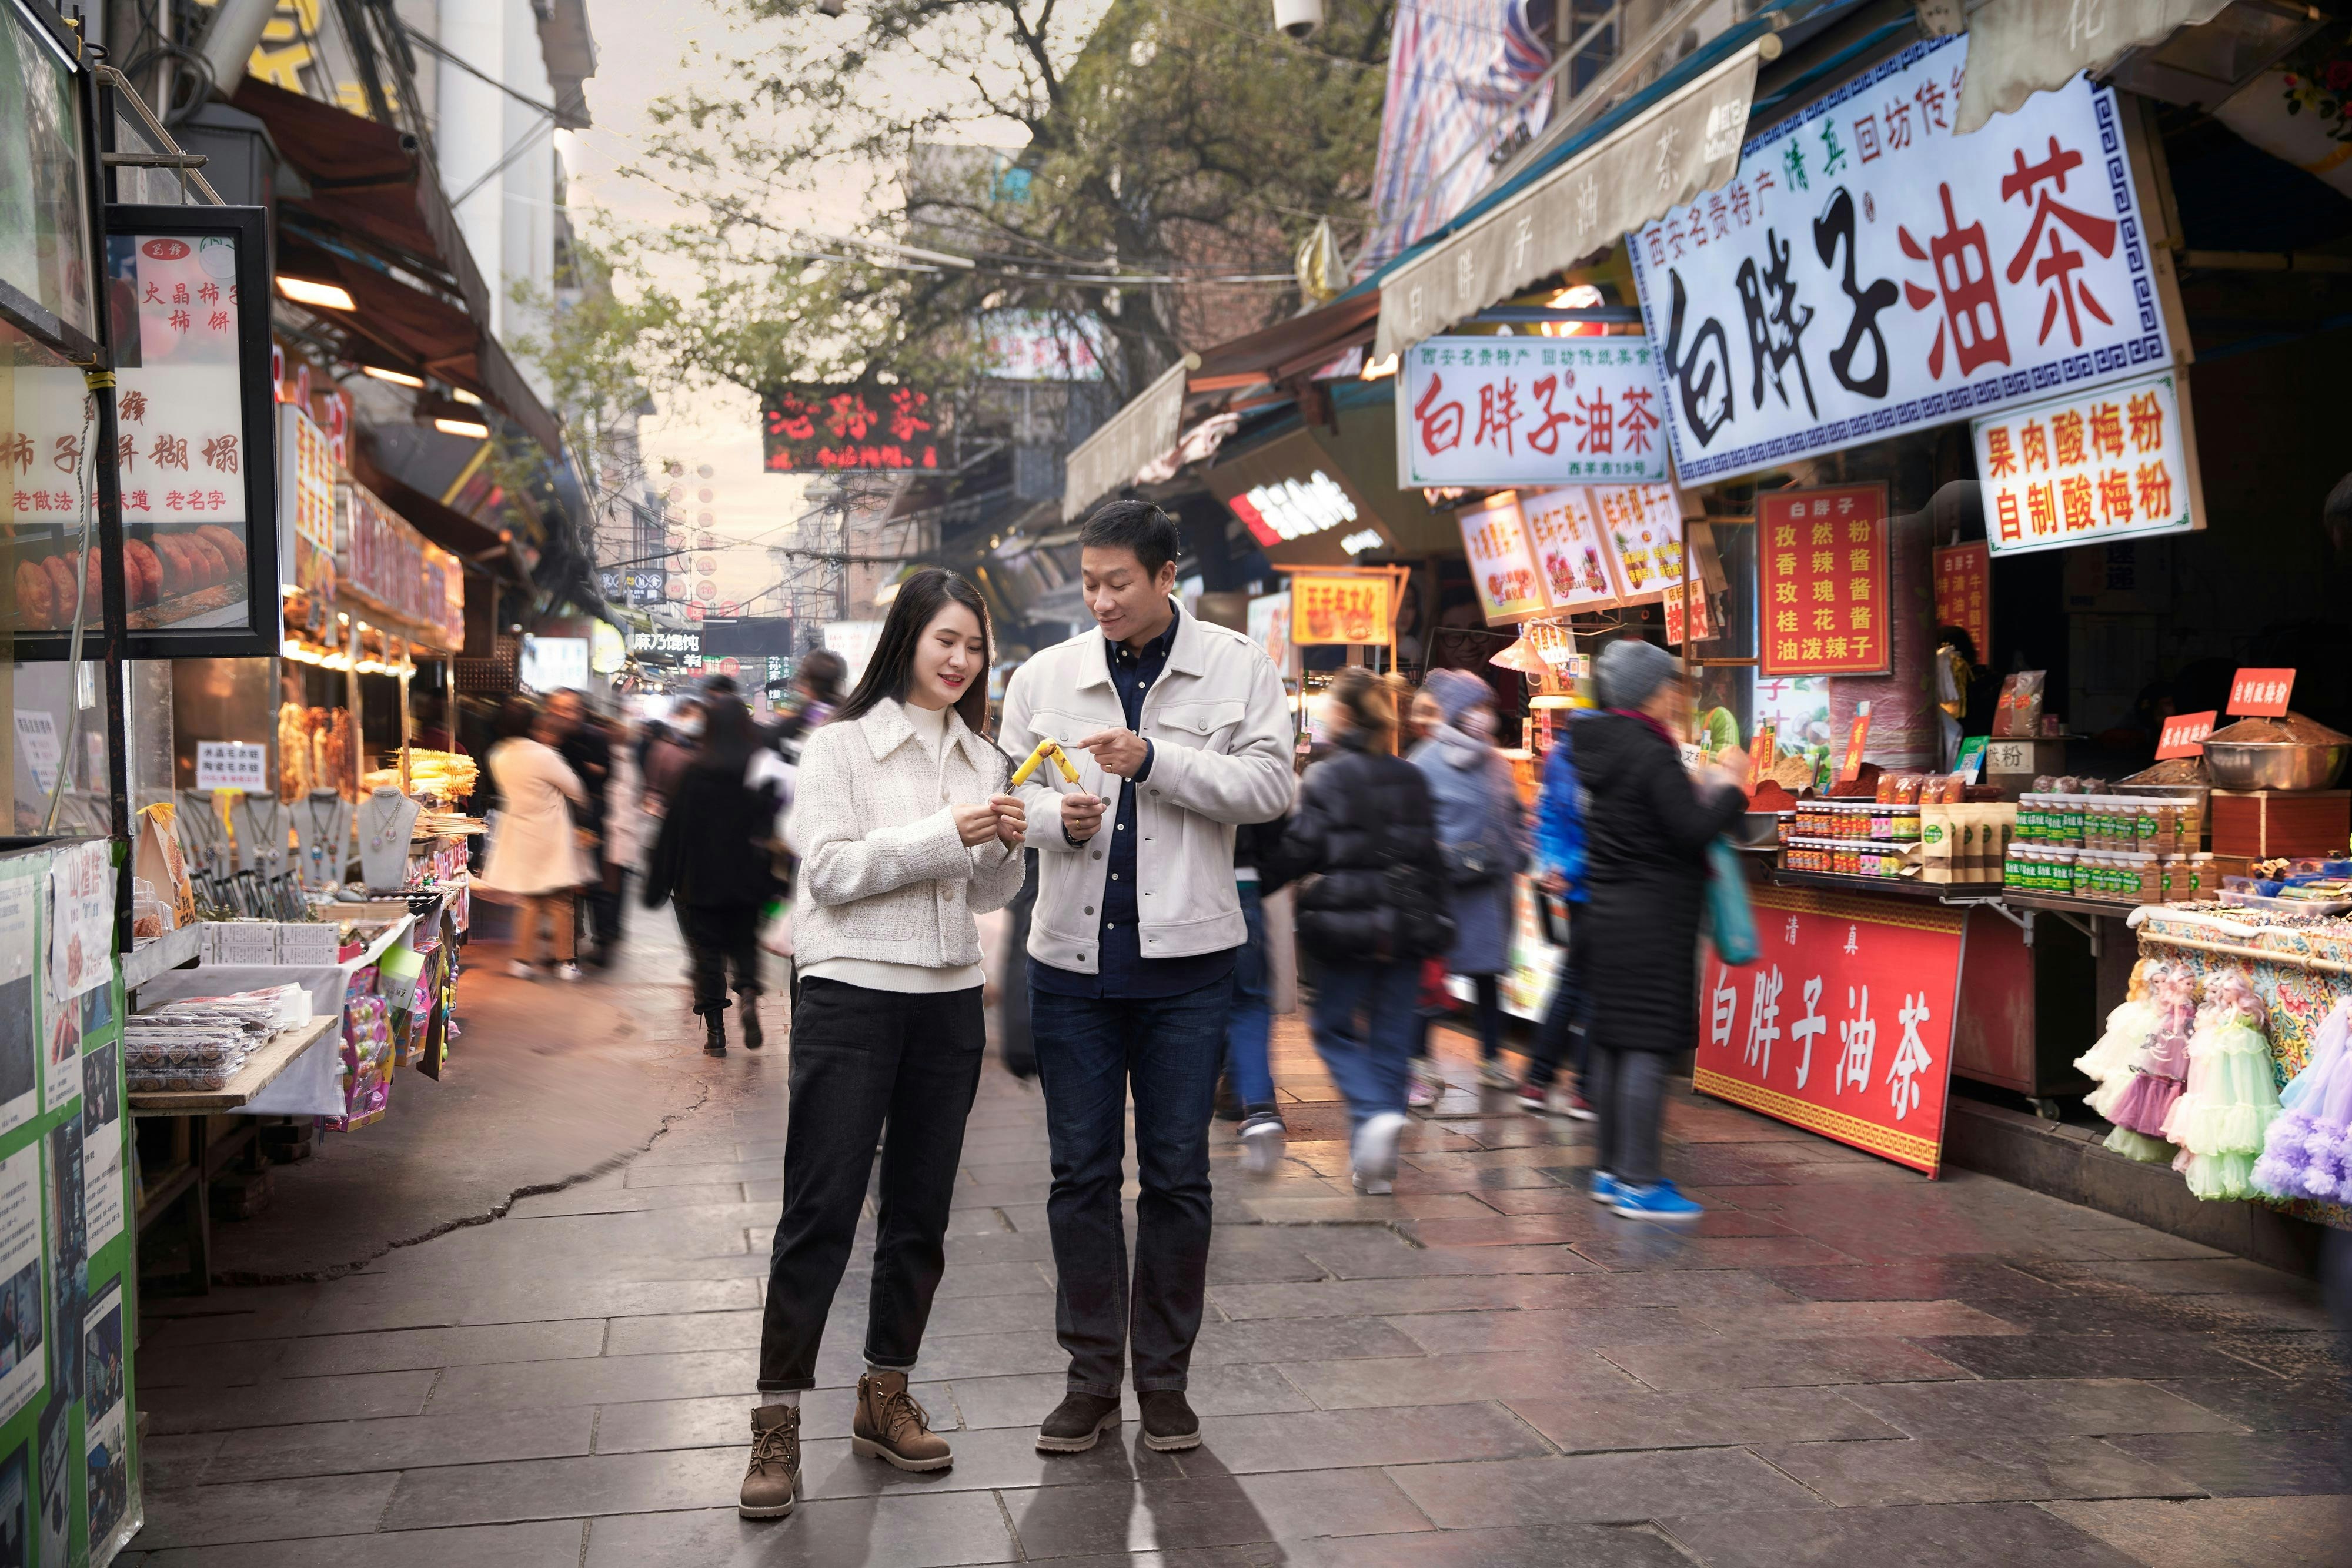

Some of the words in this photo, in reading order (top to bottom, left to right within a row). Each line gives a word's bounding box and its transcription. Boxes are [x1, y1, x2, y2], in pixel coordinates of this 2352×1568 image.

[1647, 169, 1776, 266] 西安名贵特产
[1783, 118, 1847, 192] 清真
[1666, 135, 2117, 447] 白胖子油茶
[168, 310, 230, 335] 柿饼
[1421, 348, 1529, 366] 西安名贵特产
[1543, 348, 1651, 366] 回坊传统美食
[1415, 373, 1660, 457] 白胖子油茶
[1987, 391, 2163, 481] 果肉酸梅粉
[1568, 462, 1646, 476] 西羊市19号
[13, 490, 74, 511] 老做法
[166, 490, 226, 510] 老名字
[1789, 497, 1854, 519] 白胖子
[1997, 459, 2173, 543] 自制酸梅粉
[1775, 519, 1872, 549] 孜然粉
[1776, 550, 1872, 576] 香辣酱
[1945, 555, 1974, 571] 白胖子
[1669, 582, 1698, 601] 店长荐
[1776, 578, 1872, 604] 玫瑰酱
[1776, 606, 1872, 633] 桂花酱
[1776, 635, 1873, 662] 油泼辣子
[1846, 723, 1863, 771] 香辣
[1785, 915, 1859, 955] 清真
[1711, 964, 1932, 1121] 白胖子油茶
